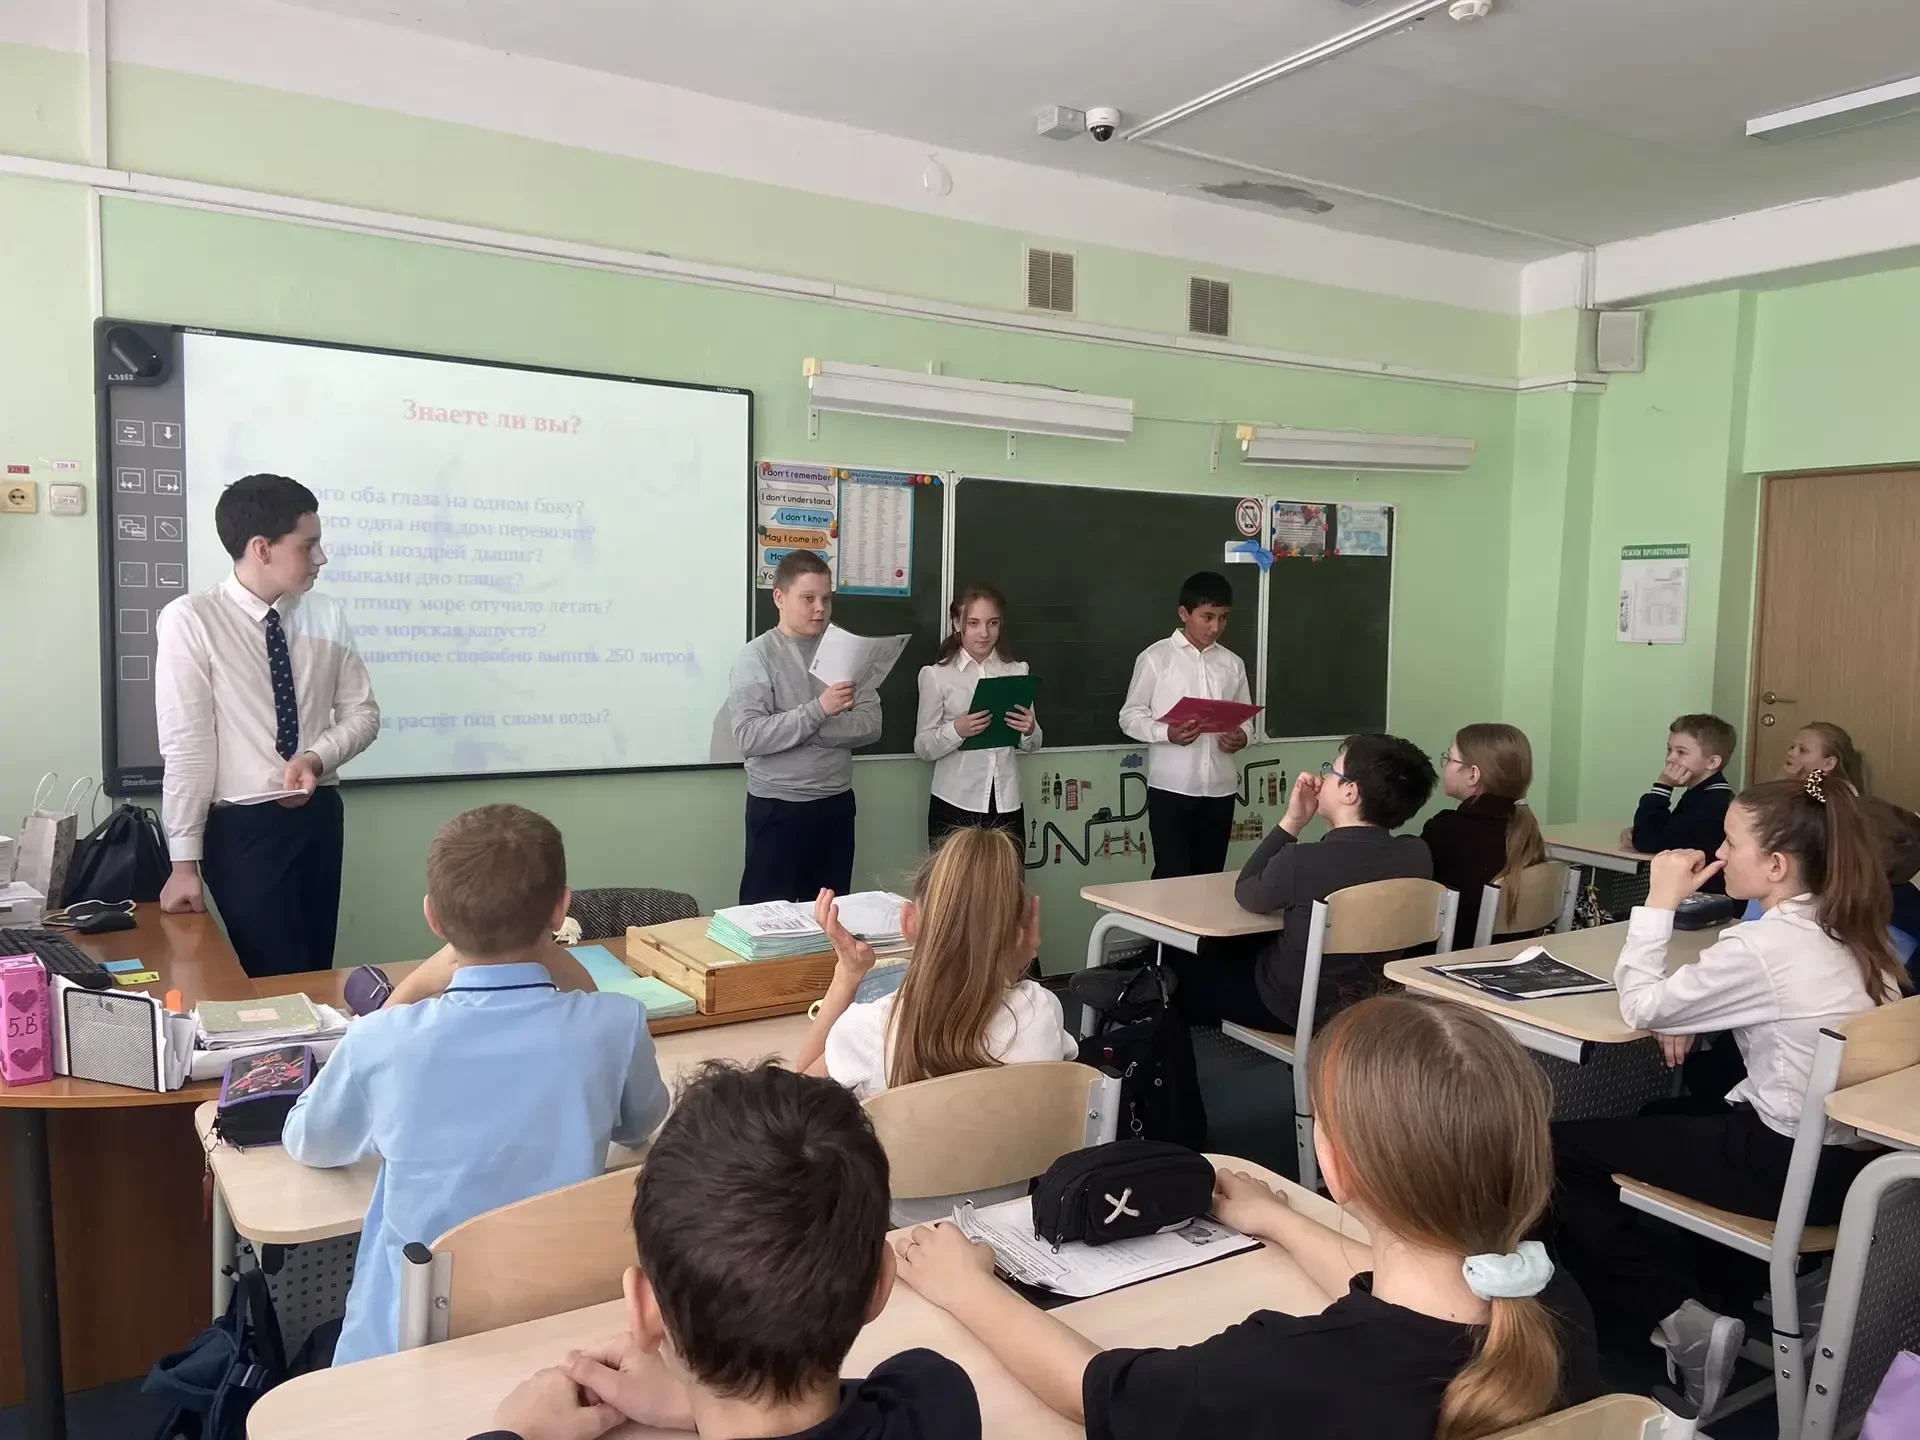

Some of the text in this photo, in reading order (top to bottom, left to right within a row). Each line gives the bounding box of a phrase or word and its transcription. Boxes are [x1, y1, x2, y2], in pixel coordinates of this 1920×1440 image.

[402, 399, 582, 435] Знаете ли вы?
[767, 468, 789, 478] don't
[311, 486, 584, 520] ого оба глаза на одном боку?
[765, 493, 786, 501] don't
[787, 495, 833, 506] understand.
[785, 513, 806, 521] don't
[357, 517, 403, 533] одна
[410, 519, 453, 534] нога
[459, 522, 493, 536] дом
[499, 523, 596, 541] перевозит?
[764, 533, 782, 543] May
[788, 536, 810, 544] come
[811, 536, 824, 544] in?
[389, 545, 467, 563] ноздрёй
[471, 548, 544, 564] дышит?
[770, 552, 783, 561] Ma
[323, 571, 524, 588] клыками дно пашет?
[762, 571, 774, 580] Yo
[354, 597, 412, 613] птицу
[419, 599, 465, 615] море
[471, 600, 544, 614] отучило
[548, 599, 613, 616] летать?
[385, 625, 463, 641] морская
[467, 623, 547, 642] капуста?
[364, 647, 695, 666] ивотное способно выпить 250 литров
[397, 712, 457, 730] растёт
[463, 714, 496, 728] под
[502, 713, 554, 726] слоем
[559, 709, 611, 728] воды?
[121, 779, 164, 787] StarBoar
